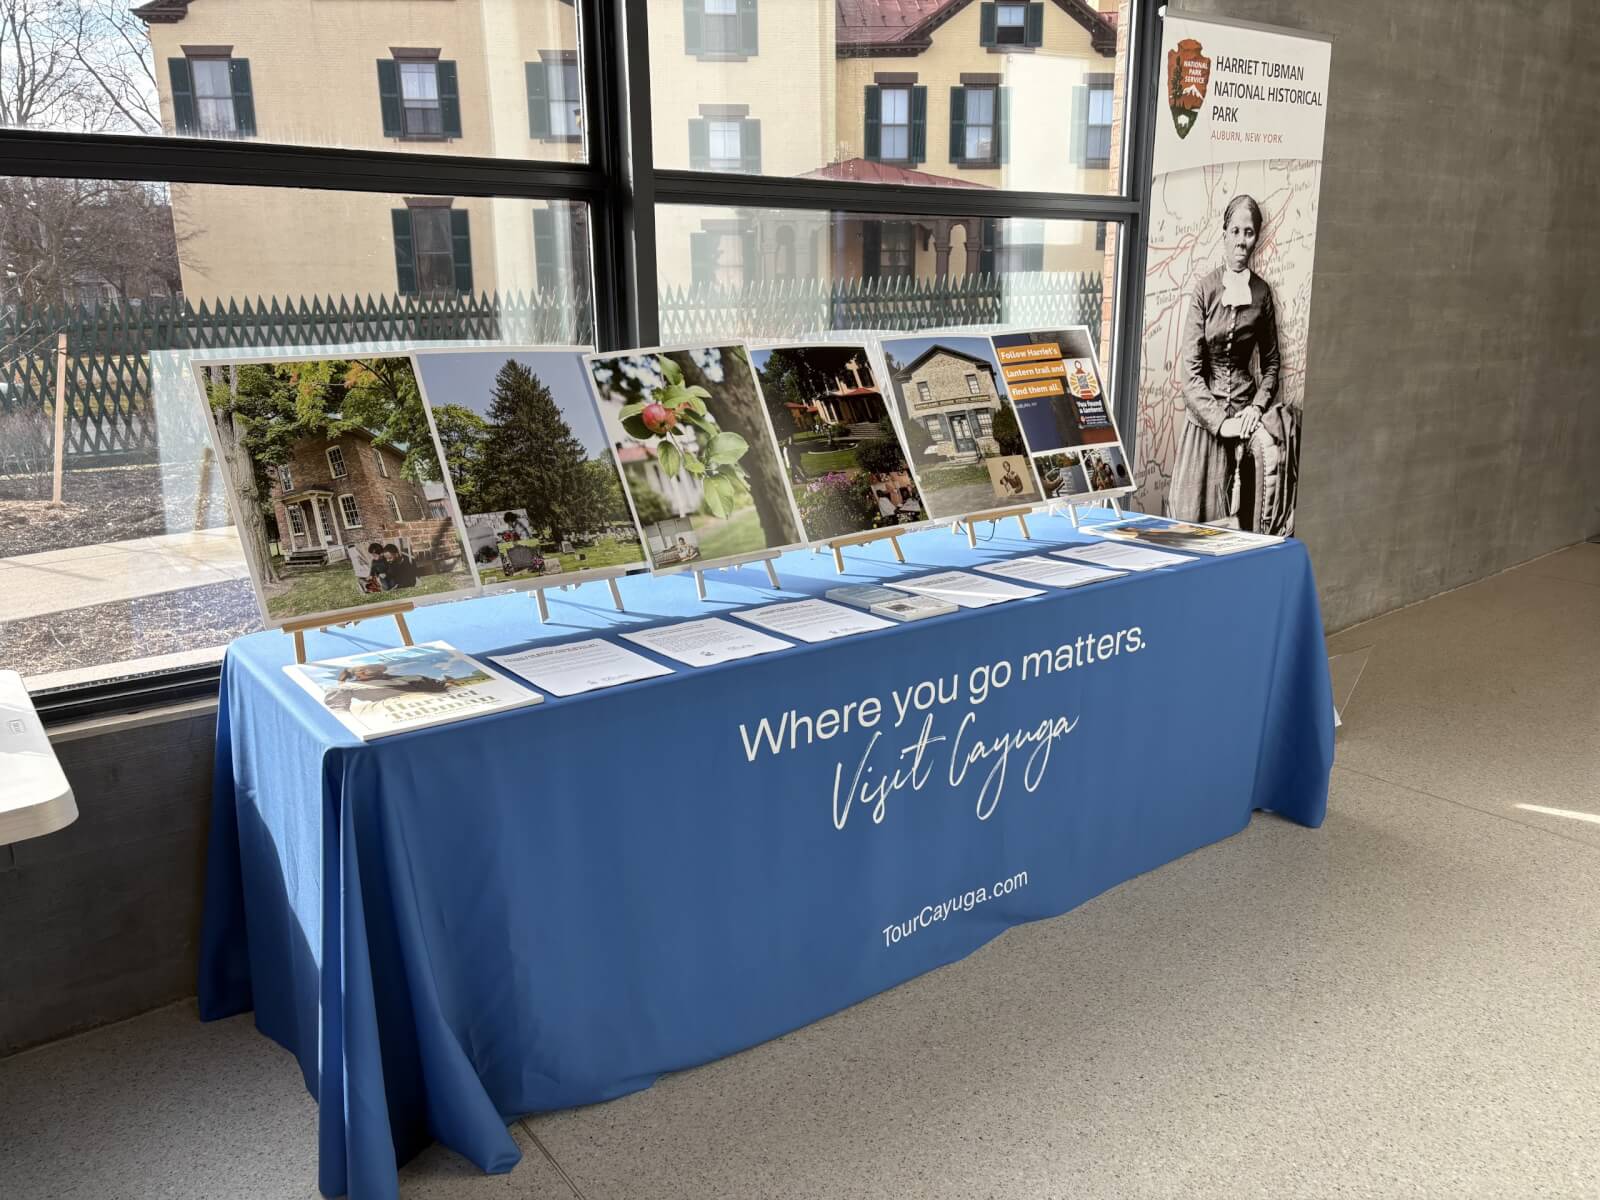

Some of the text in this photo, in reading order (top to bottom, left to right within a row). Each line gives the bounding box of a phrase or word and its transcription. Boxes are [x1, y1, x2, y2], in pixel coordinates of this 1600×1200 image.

[1183, 60, 1208, 70] NATIONAL
[1216, 56, 1304, 81] HARRIET TUBMAN
[1184, 76, 1205, 84] SERVICE
[1214, 81, 1322, 106] NATIONAL HISTORICAL
[1212, 106, 1238, 122] PARK
[1211, 130, 1283, 143] AUBURN, NEW YORK
[1000, 347, 1058, 360] Follow Harriet's
[1006, 365, 1064, 378] Lantern trail and
[1012, 387, 1028, 396] Find
[1028, 386, 1048, 394] them
[739, 626, 1147, 763] Where you go matters.
[832, 711, 1080, 830] Visit Cayuga
[882, 869, 1029, 948] TourCayuga.com
